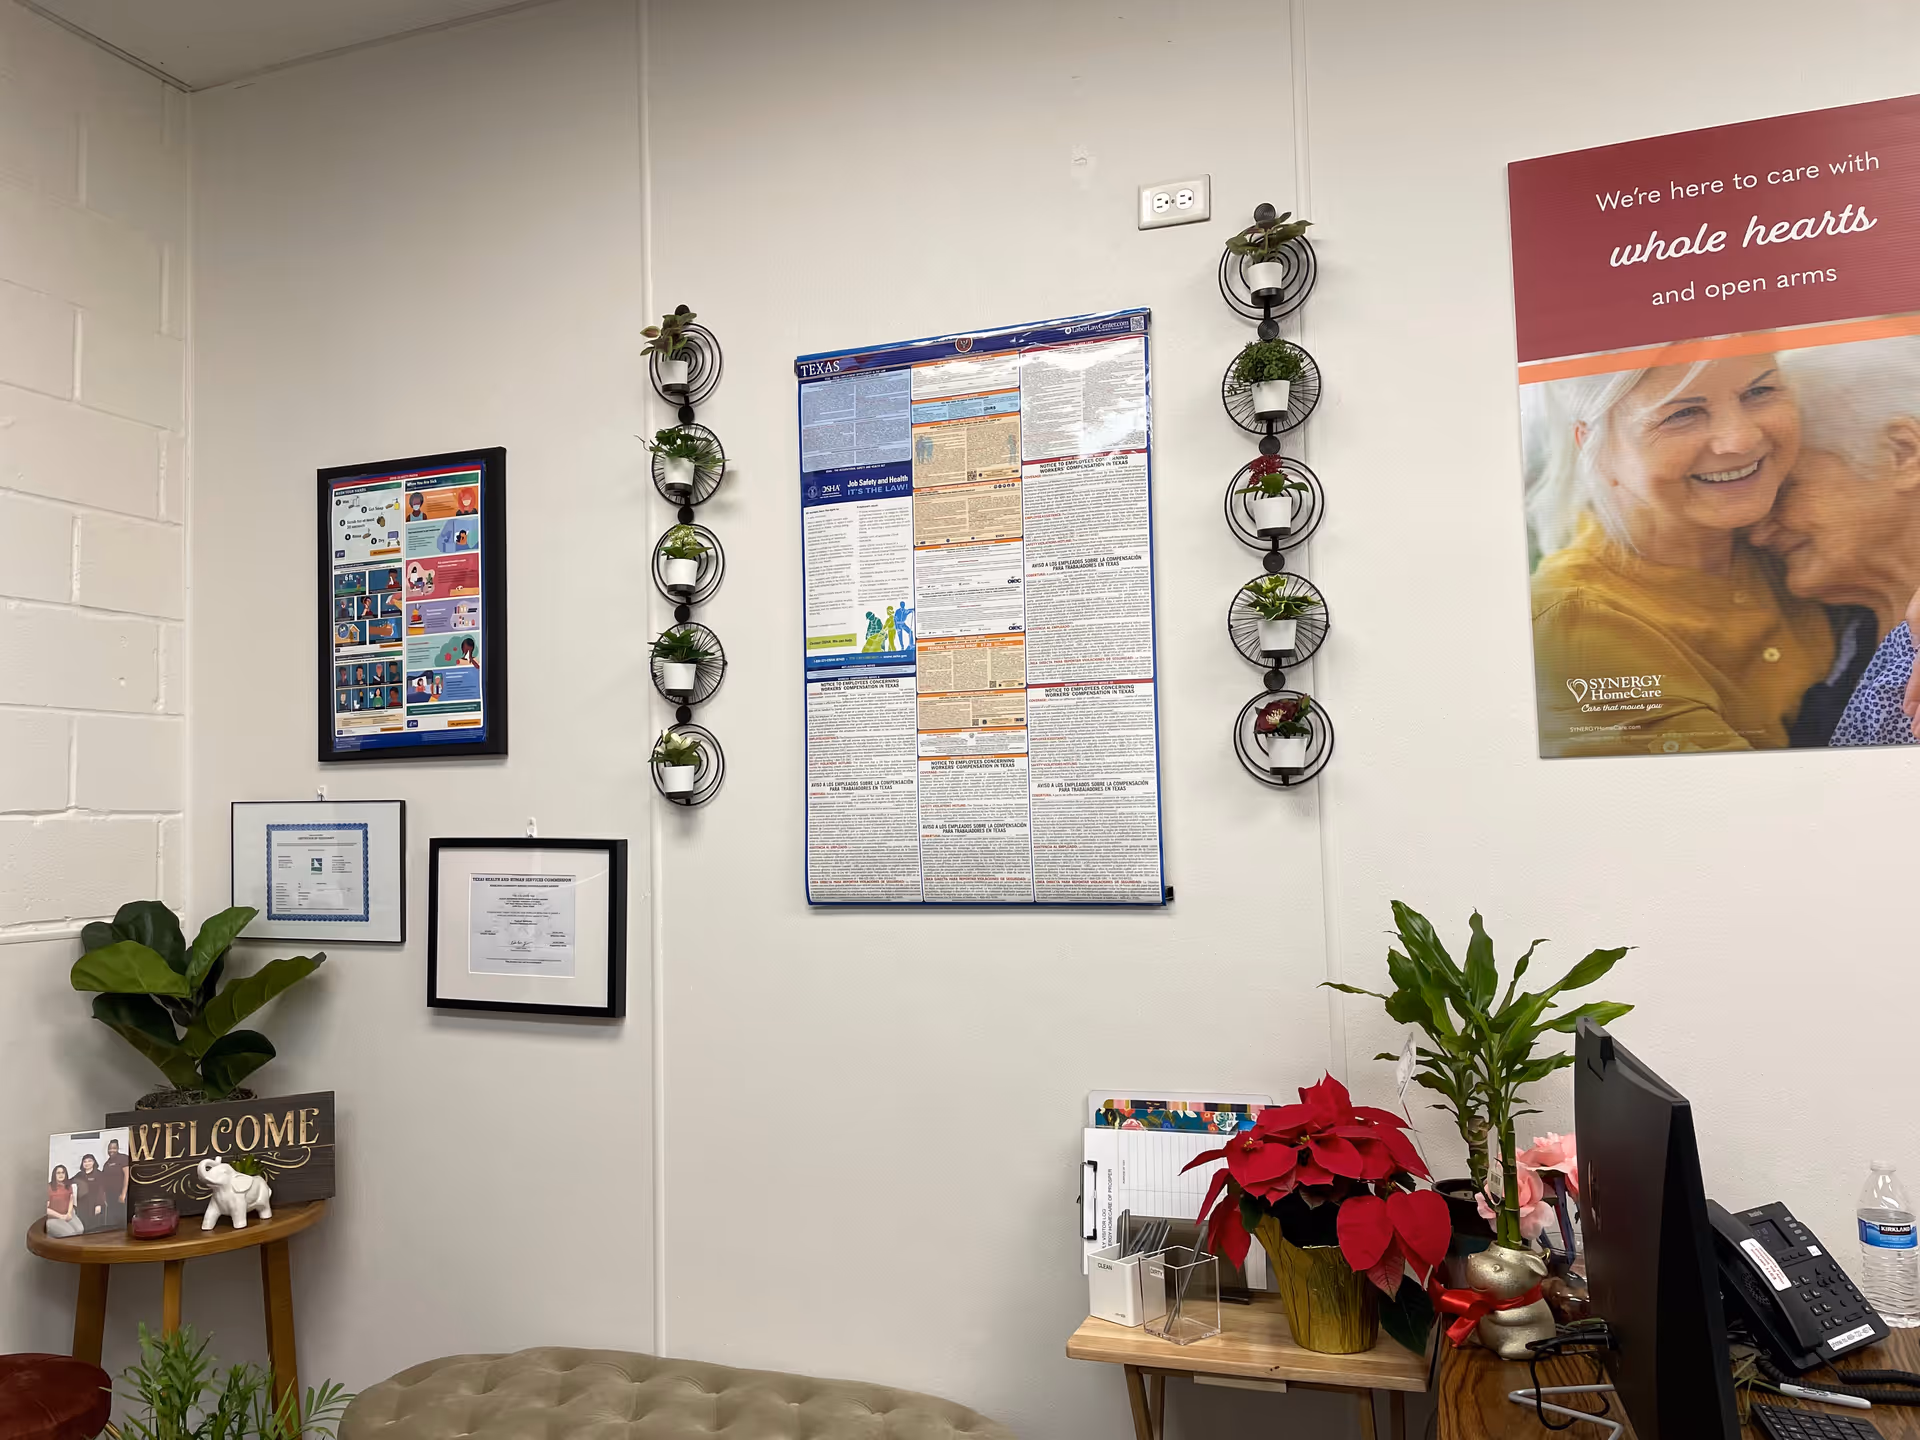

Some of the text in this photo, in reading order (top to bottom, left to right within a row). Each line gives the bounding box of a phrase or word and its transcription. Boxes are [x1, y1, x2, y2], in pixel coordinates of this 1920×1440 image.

[1595, 151, 1880, 212] We're here to care with
[1609, 203, 1878, 268] whole hearts
[1651, 267, 1838, 306] and open arms
[800, 360, 840, 376] TEXAS
[889, 476, 908, 484] Health
[885, 484, 908, 492] LAW!
[1590, 675, 1662, 689] SYNERGY
[1591, 688, 1662, 700] HomeCare
[1581, 704, 1601, 712] Care
[128, 1108, 320, 1162] WELCOME
[1098, 1262, 1112, 1271] CLEAN
[1150, 1268, 1163, 1276] DIRTY
